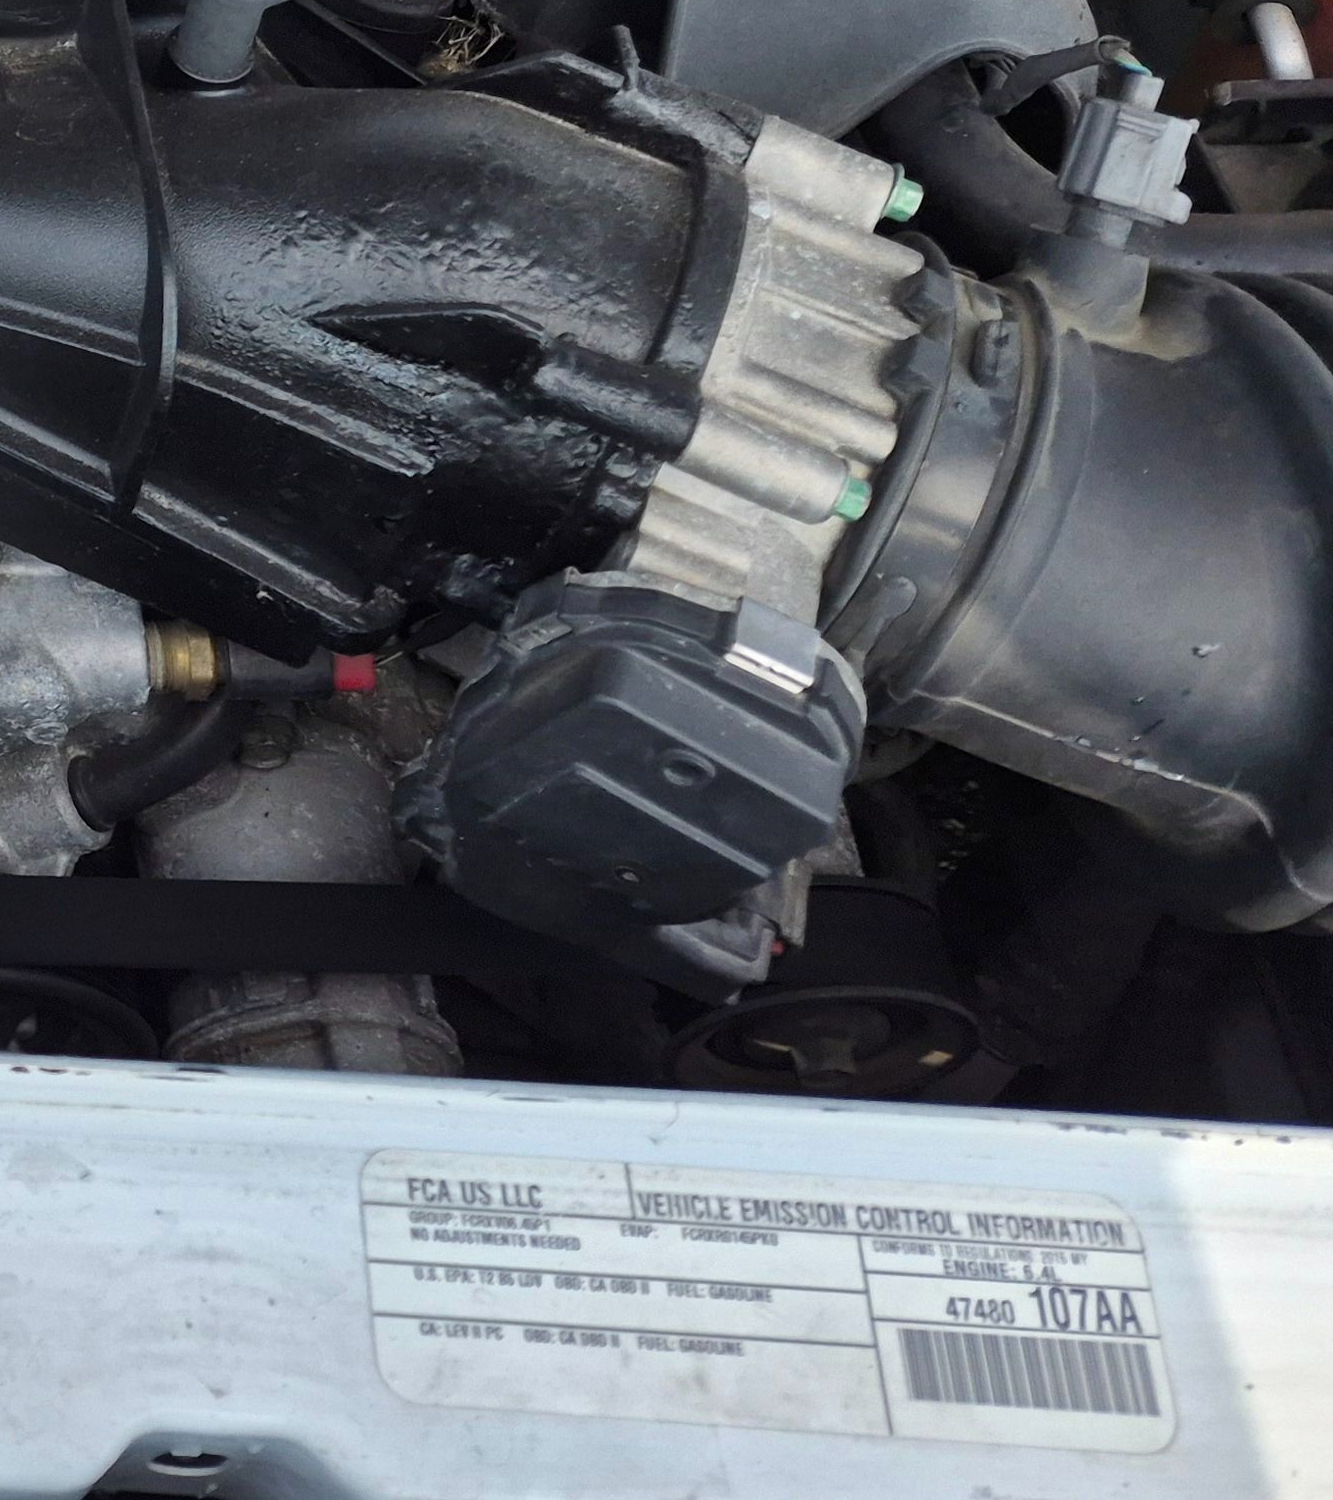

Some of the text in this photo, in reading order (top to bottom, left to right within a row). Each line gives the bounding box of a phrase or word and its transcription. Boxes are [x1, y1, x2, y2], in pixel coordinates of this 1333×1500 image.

[407, 1177, 544, 1210] FCA US LLC
[637, 1192, 1126, 1247] VEHICLE EMISSION CONTROL INFORMATION
[433, 1228, 527, 1248] ADJUSTMENTS
[530, 1234, 582, 1251] NEEDED
[942, 1258, 1062, 1283] ENGINE: 6.4L
[708, 1285, 774, 1303] GASOLINE
[944, 1286, 1144, 1334] 47480 107AA
[679, 1338, 745, 1357] GASOLINE
